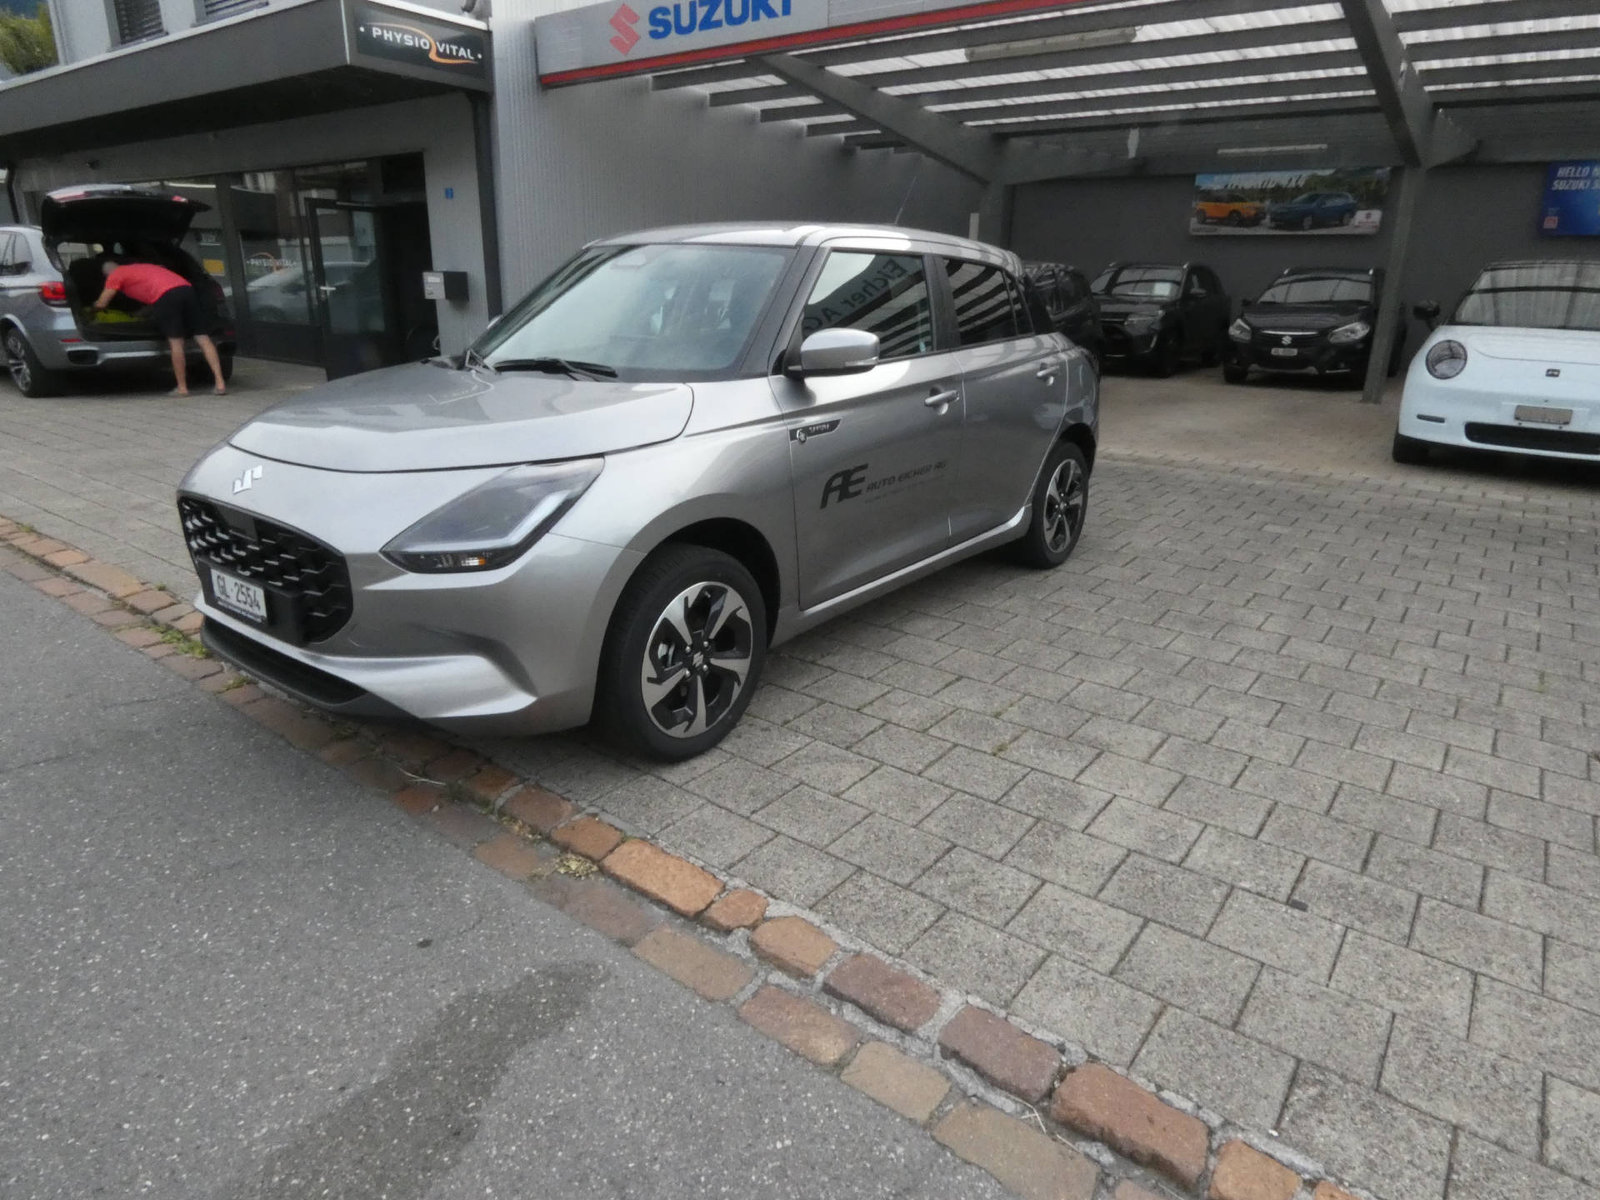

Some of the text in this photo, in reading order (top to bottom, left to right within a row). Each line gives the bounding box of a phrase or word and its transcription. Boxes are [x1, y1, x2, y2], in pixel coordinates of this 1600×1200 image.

[648, 0, 792, 40] SUZUKI
[372, 26, 474, 60] PHYSIO VITAL
